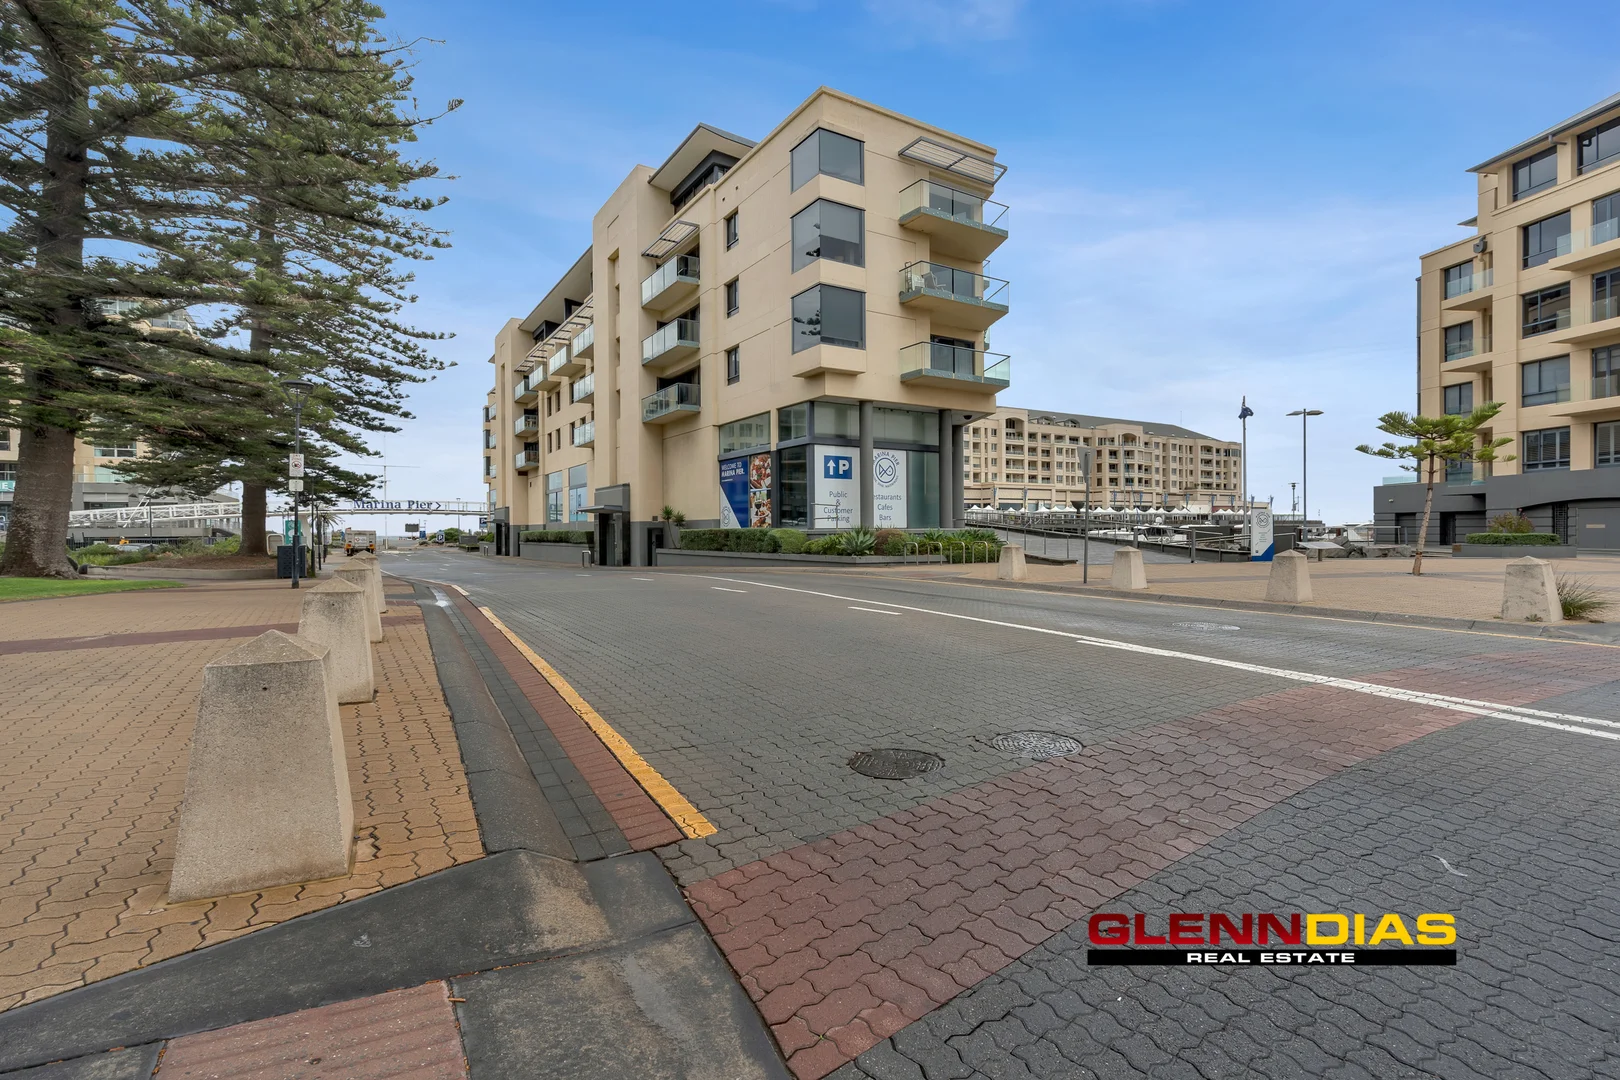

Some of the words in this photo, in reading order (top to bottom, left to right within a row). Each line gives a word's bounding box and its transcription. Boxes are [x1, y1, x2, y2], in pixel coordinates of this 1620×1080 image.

[890, 454, 900, 466] PIER
[722, 462, 736, 470] WELCOME
[838, 460, 850, 474] P
[722, 469, 736, 477] MARINA
[353, 500, 400, 509] Marina
[408, 500, 432, 509] Pier
[827, 514, 850, 523] Parking
